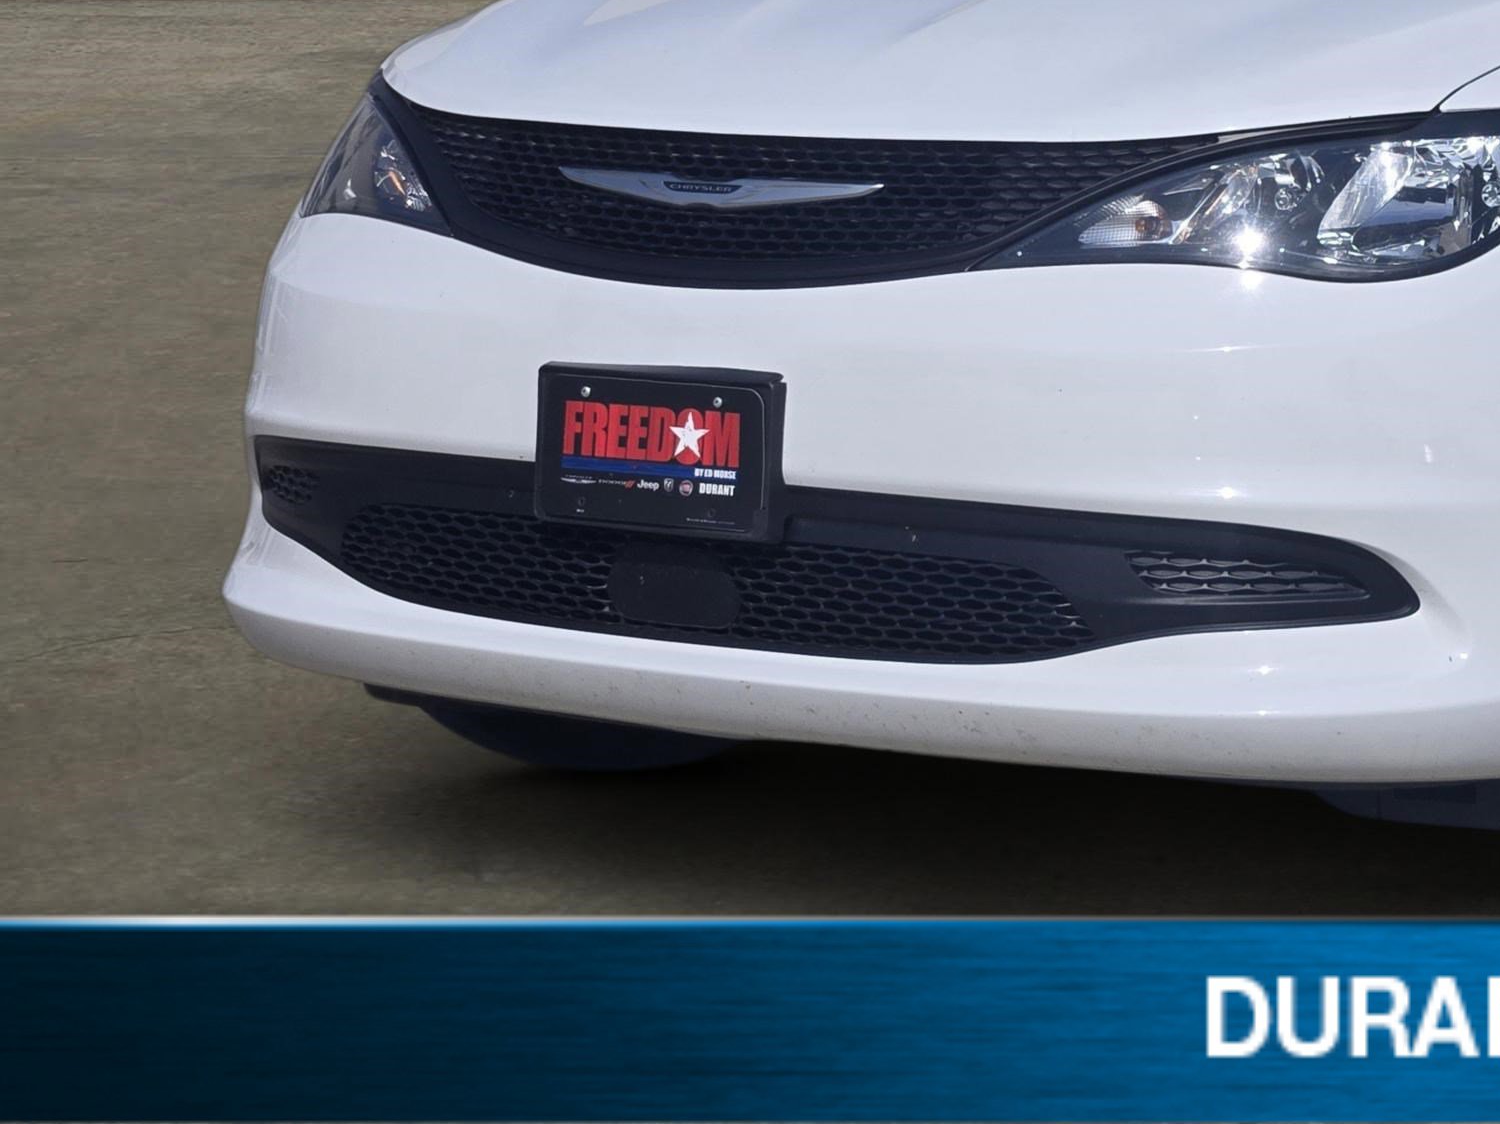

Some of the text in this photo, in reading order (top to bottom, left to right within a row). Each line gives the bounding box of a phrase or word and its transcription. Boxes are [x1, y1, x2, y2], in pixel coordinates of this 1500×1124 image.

[561, 399, 741, 468] FREEDOM
[637, 479, 660, 492] Jeep
[699, 482, 736, 497] DURANT
